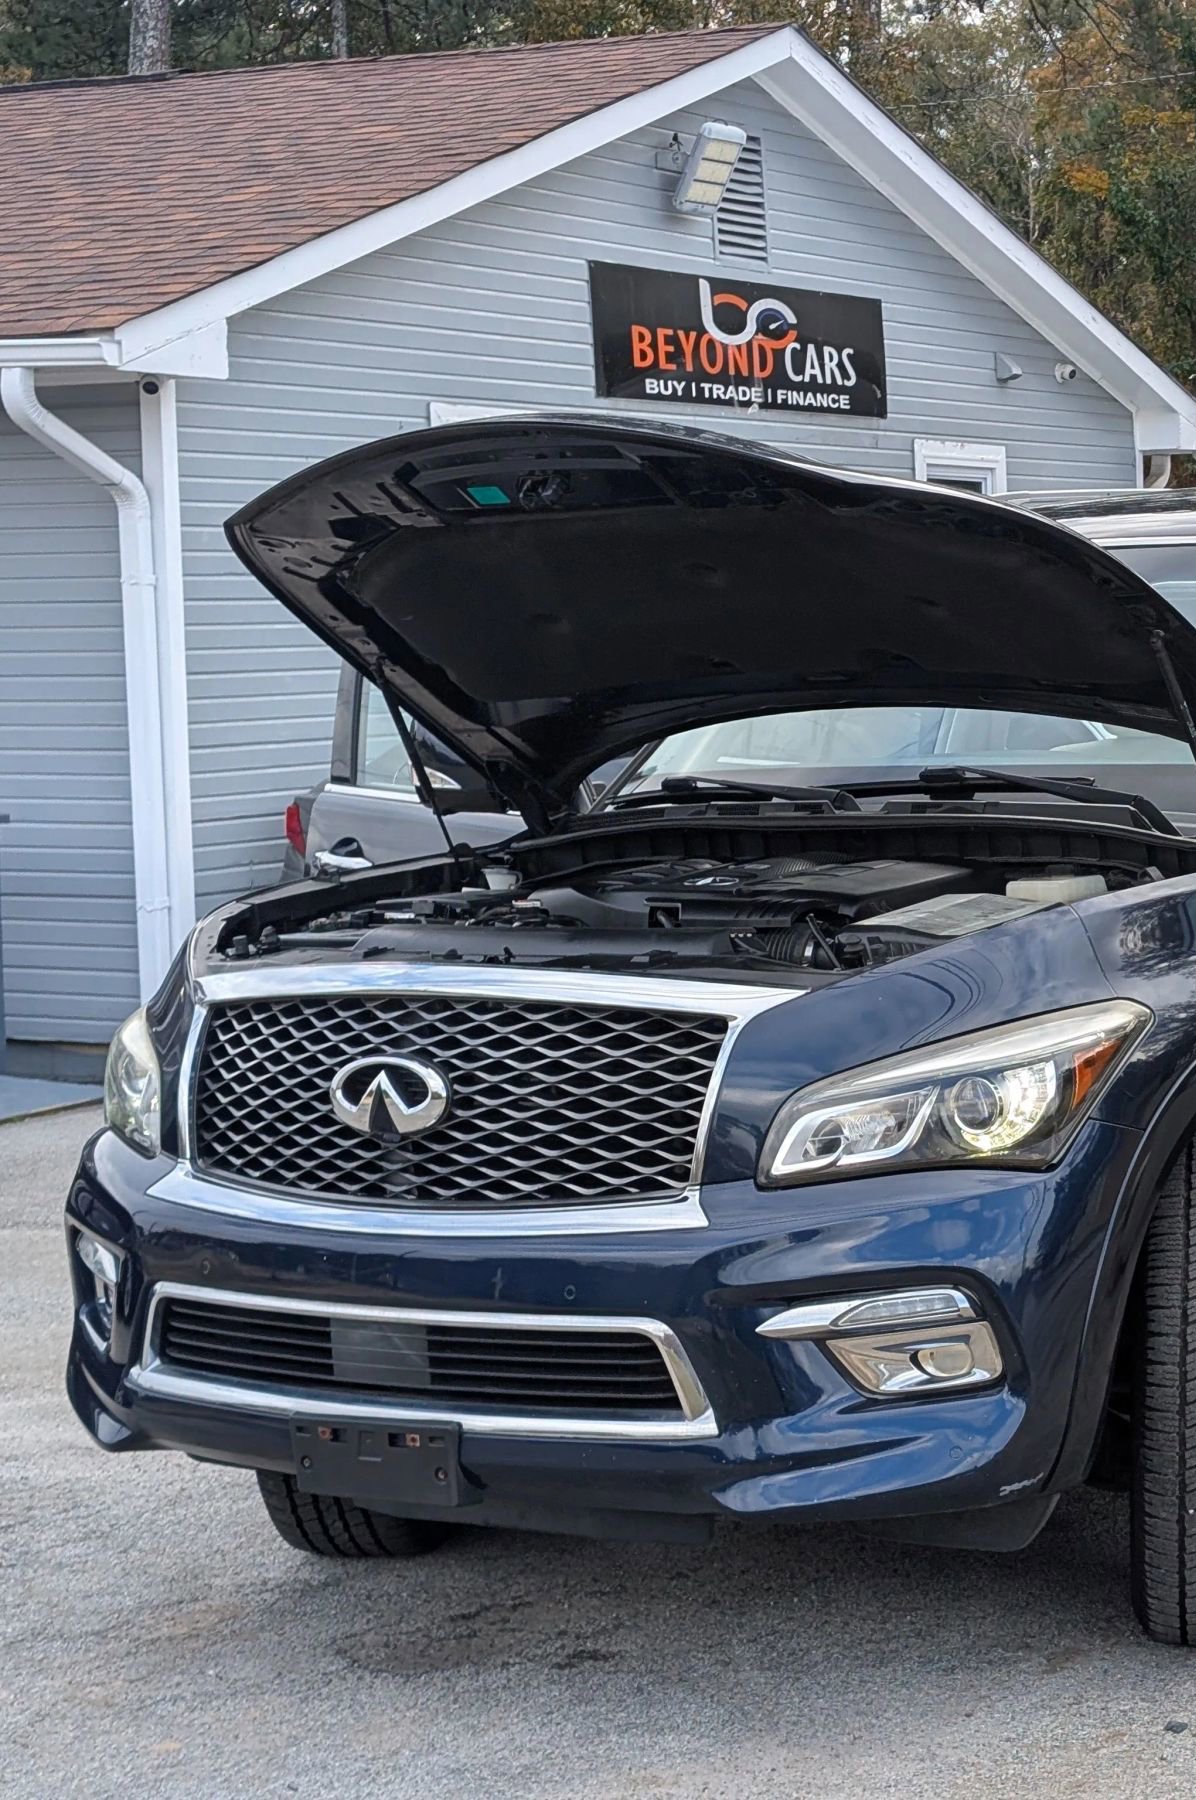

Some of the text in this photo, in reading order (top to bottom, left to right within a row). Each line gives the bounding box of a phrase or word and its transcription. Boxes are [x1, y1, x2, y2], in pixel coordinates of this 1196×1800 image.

[631, 324, 857, 387] BEYOND CARS
[645, 378, 686, 397] BUY
[700, 382, 763, 402] TRADE
[777, 390, 851, 409] FINANCE
